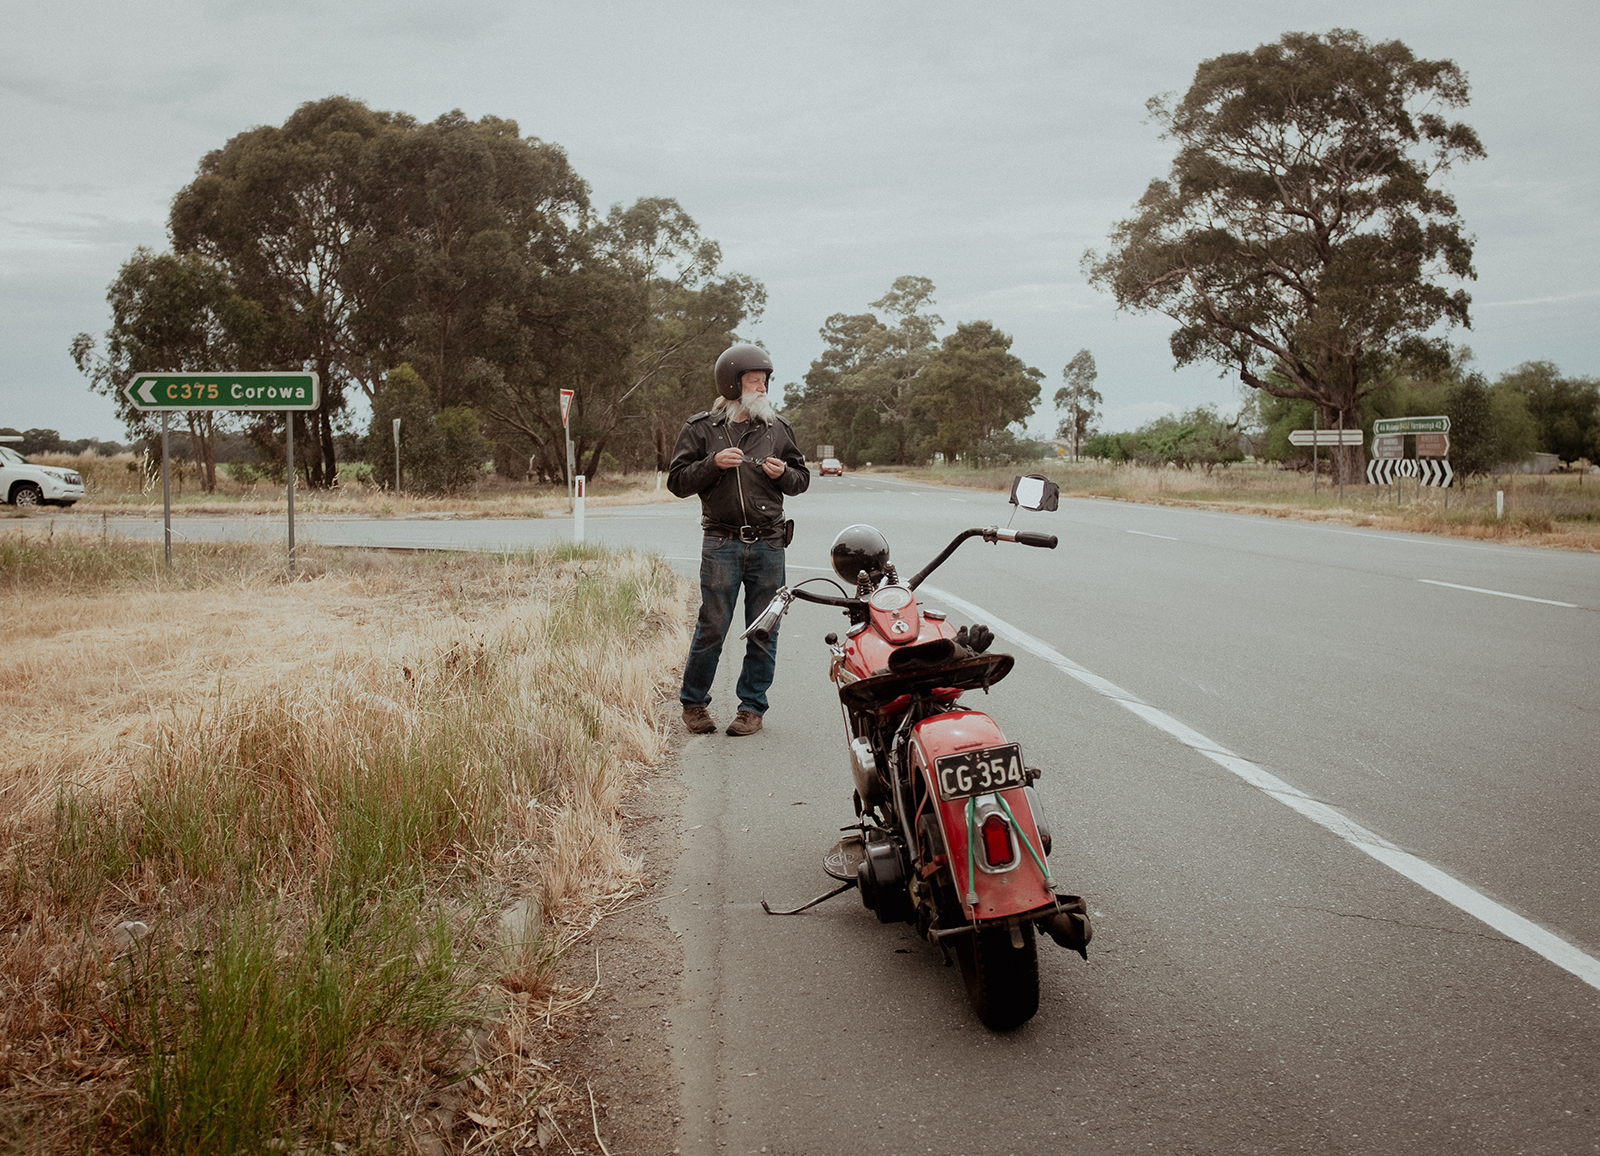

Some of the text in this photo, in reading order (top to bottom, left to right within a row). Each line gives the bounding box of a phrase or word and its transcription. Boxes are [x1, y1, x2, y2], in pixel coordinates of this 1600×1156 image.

[166, 383, 305, 399] C375 Corowa
[965, 752, 990, 761] VIC
